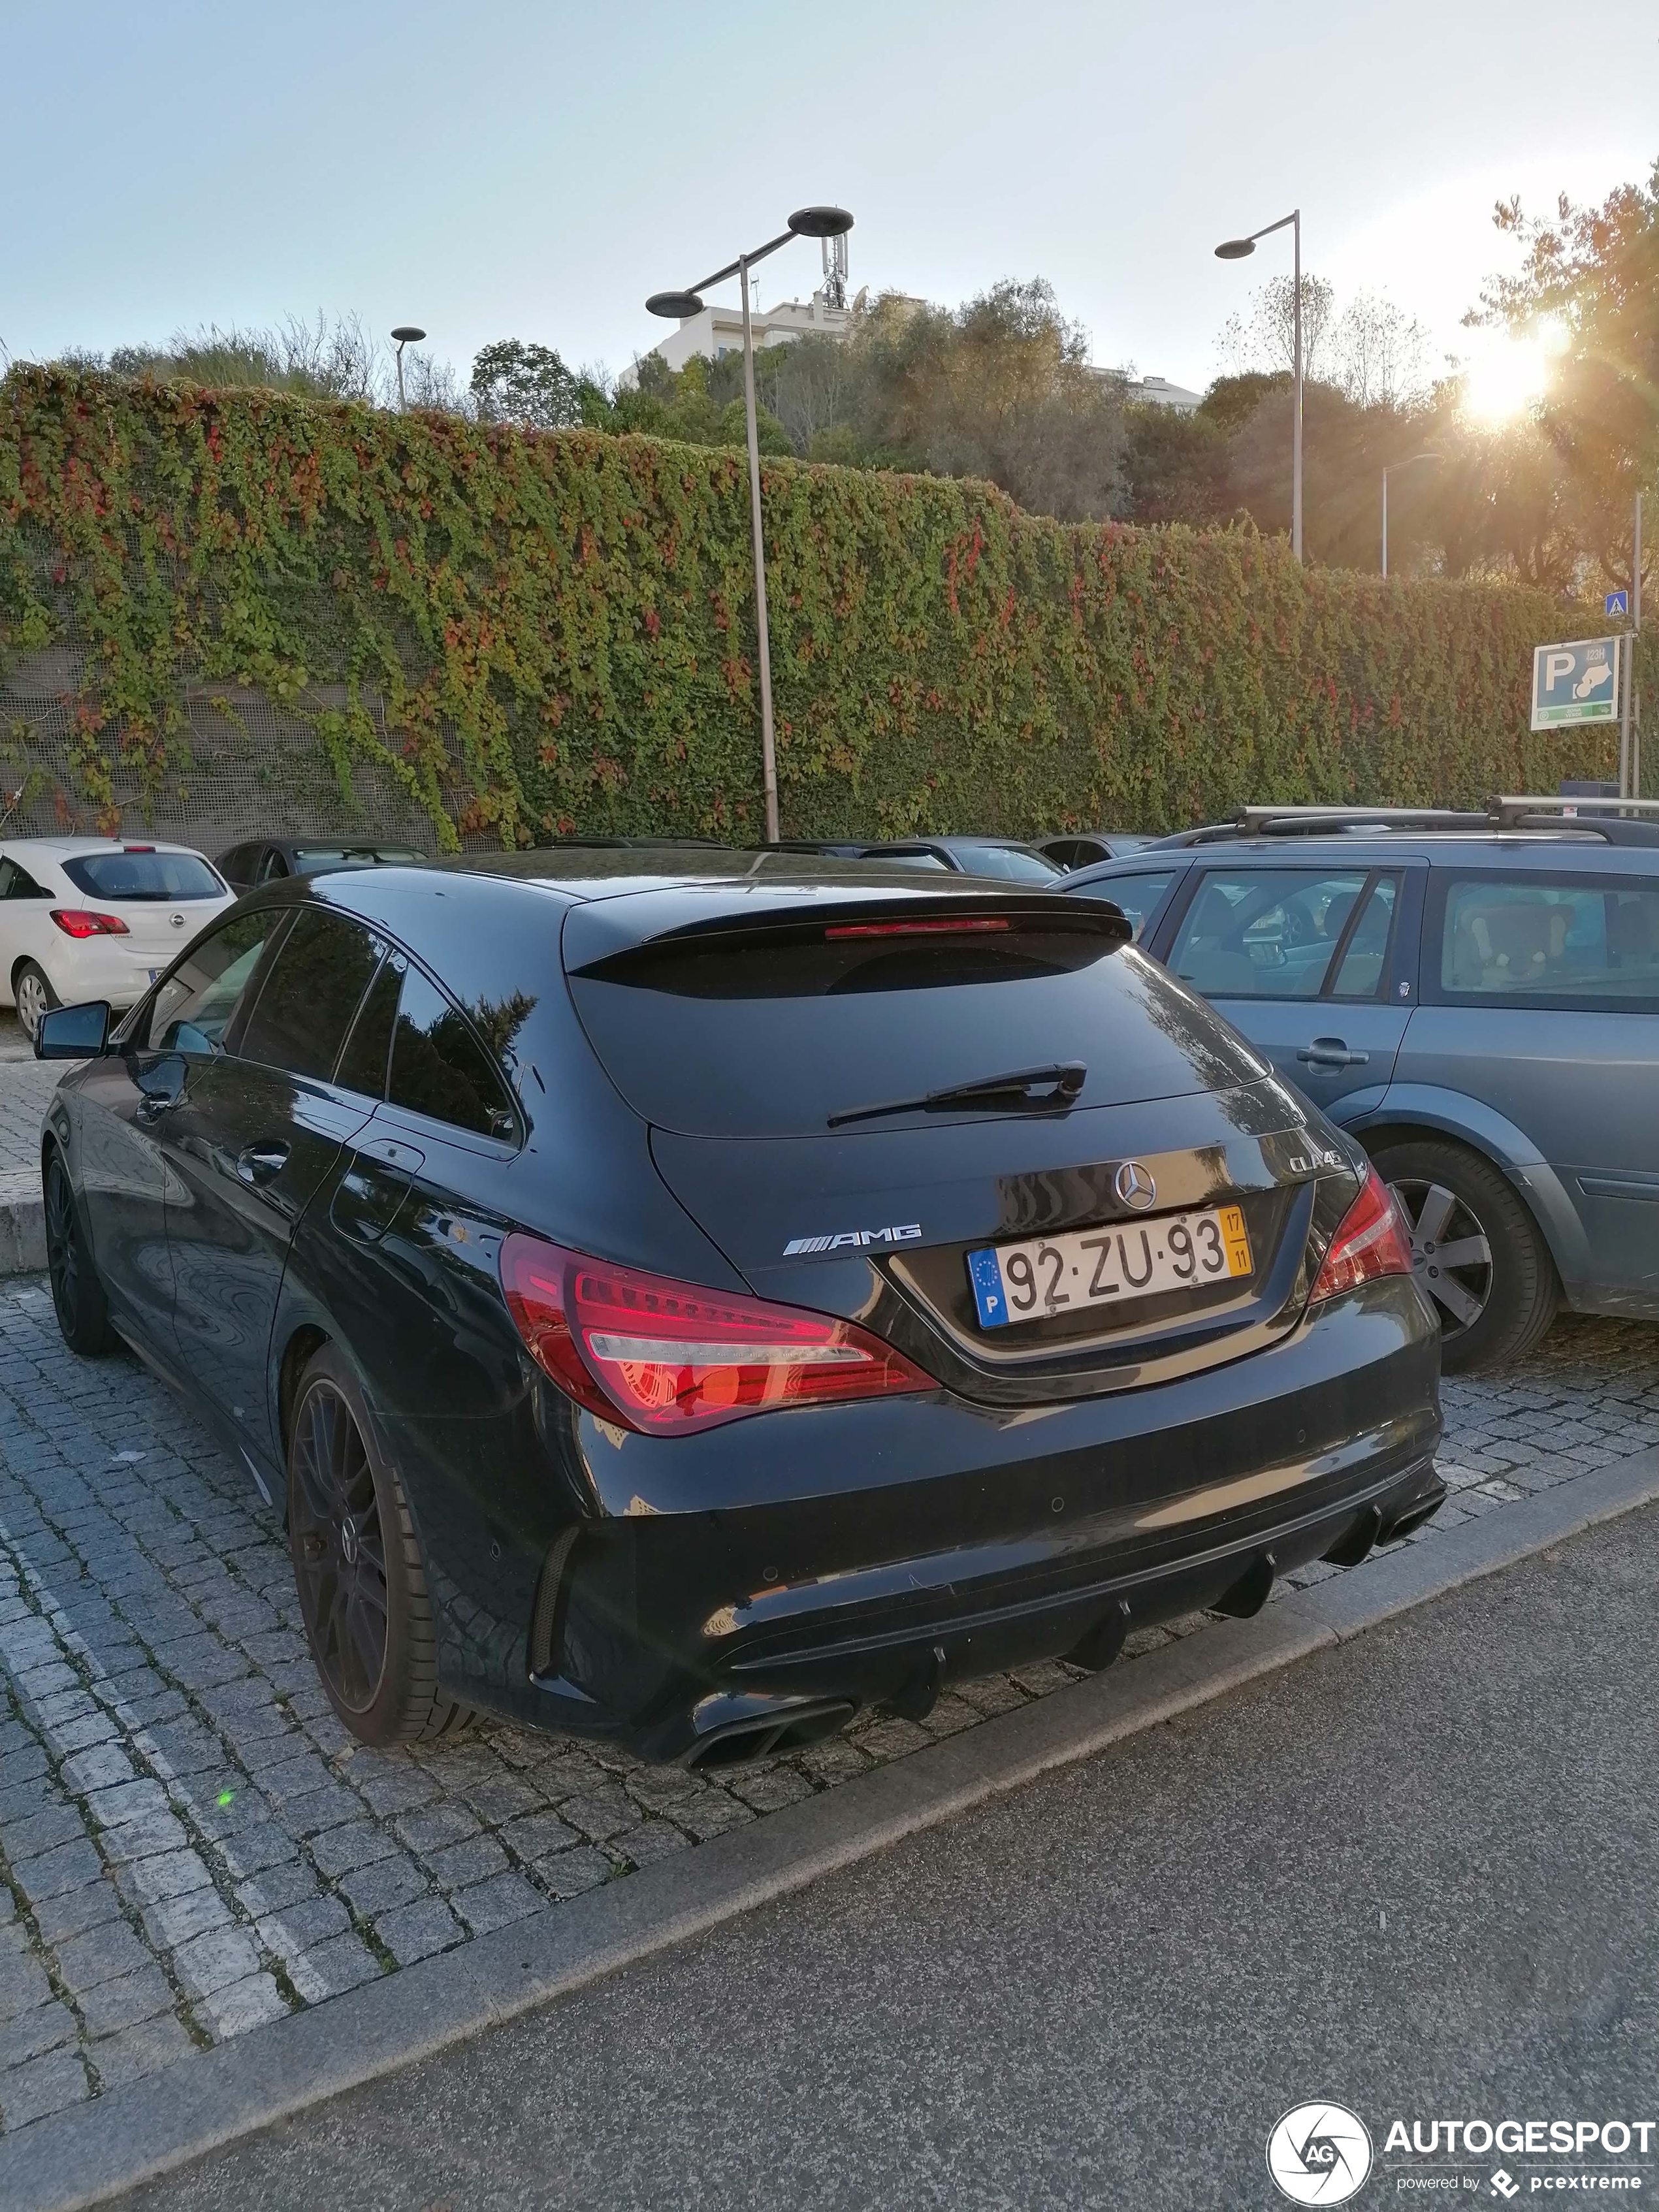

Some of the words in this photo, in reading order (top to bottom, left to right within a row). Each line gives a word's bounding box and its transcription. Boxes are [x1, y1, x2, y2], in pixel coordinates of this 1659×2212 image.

[1545, 652, 1576, 691] P
[1289, 1154, 1324, 1173] CLA
[1323, 1150, 1342, 1165] 45
[1227, 1213, 1239, 1232] 17
[1235, 1249, 1247, 1268] 11
[986, 1296, 999, 1313] P
